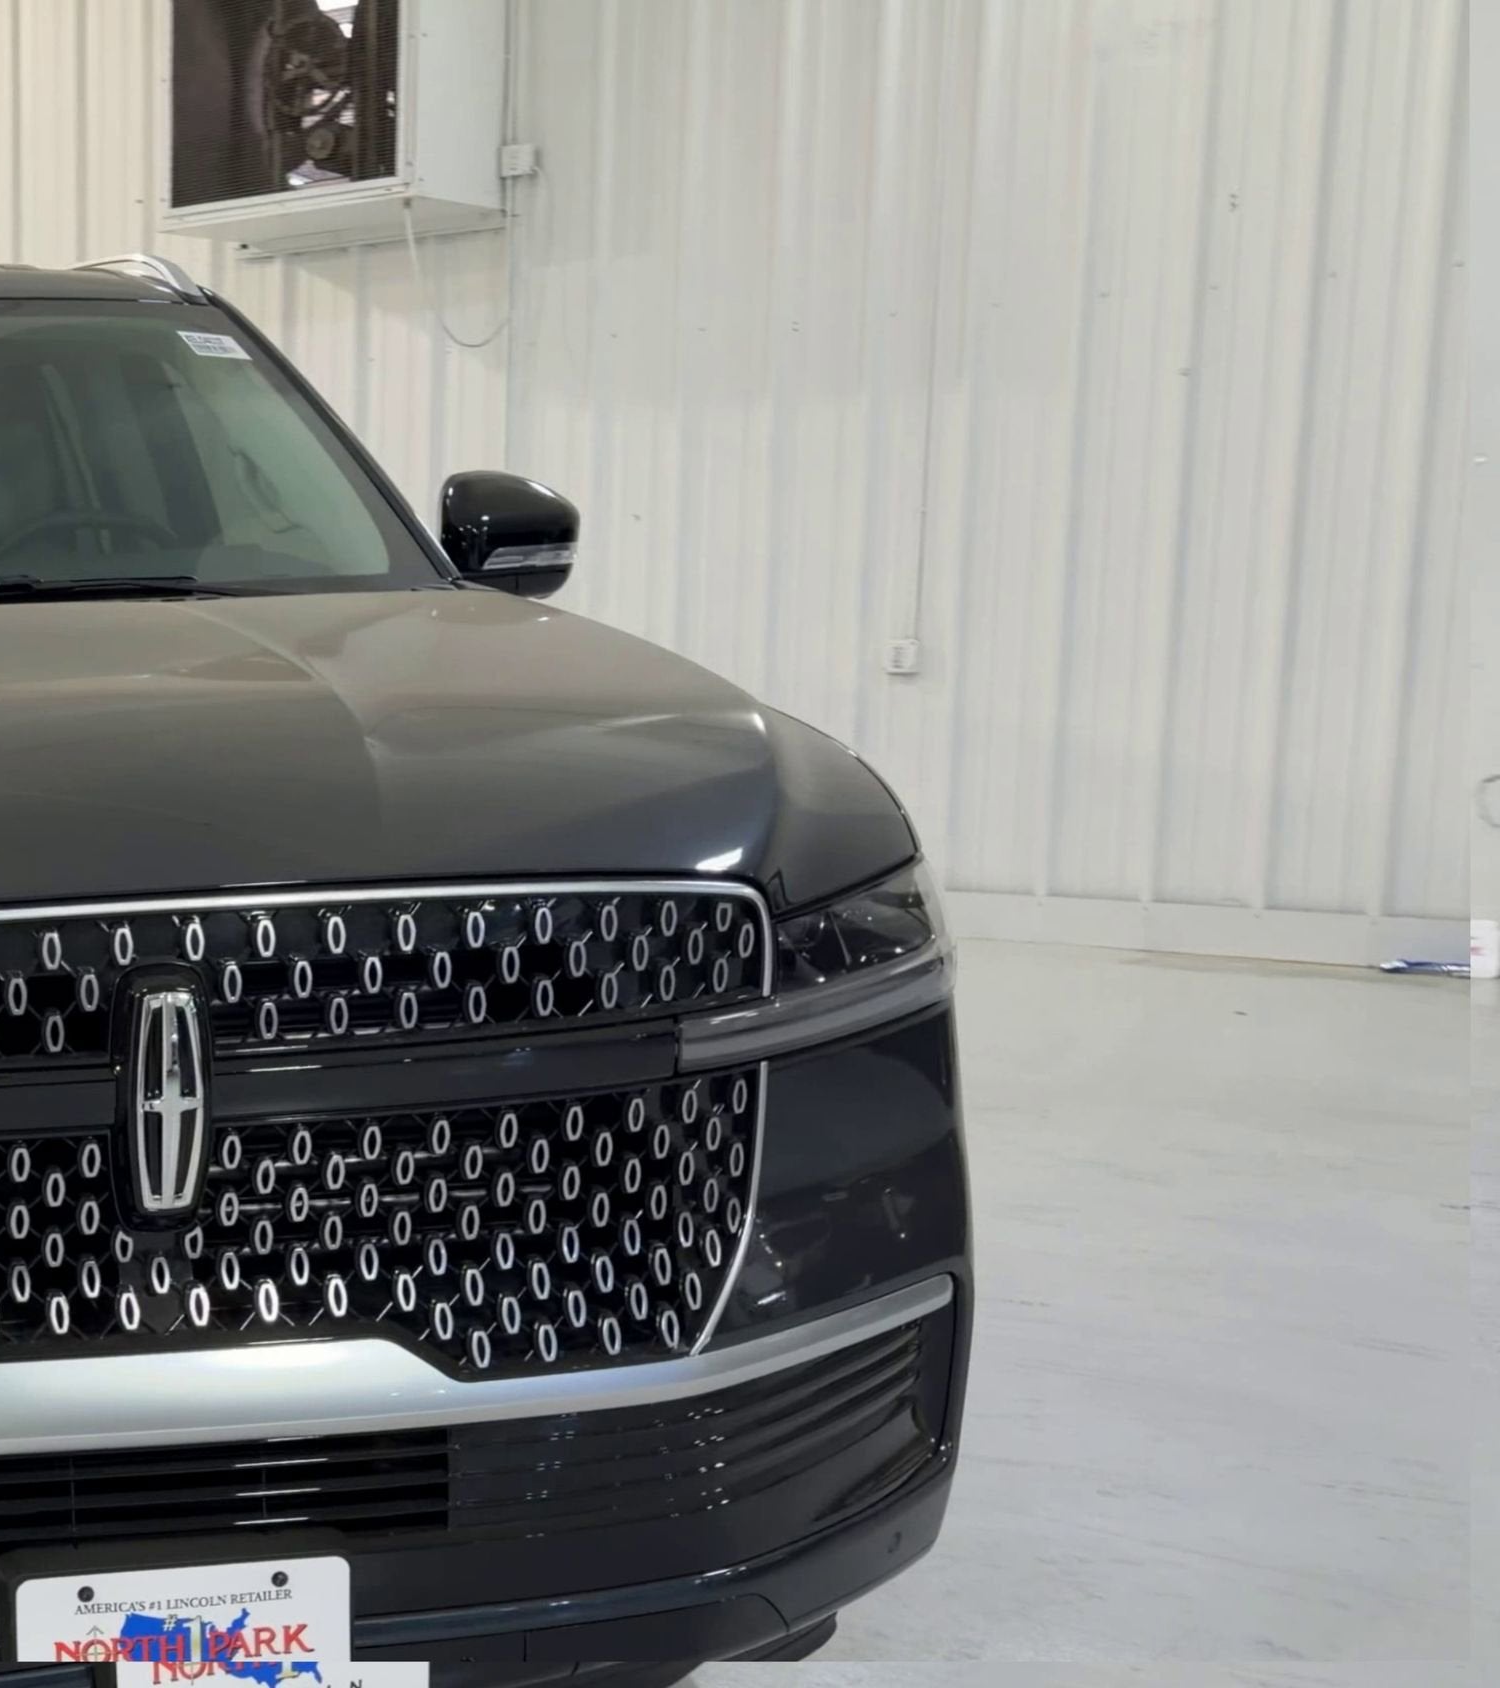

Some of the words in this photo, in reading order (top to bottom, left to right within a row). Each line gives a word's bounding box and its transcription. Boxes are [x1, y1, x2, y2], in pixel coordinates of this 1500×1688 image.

[74, 1600, 146, 1615] AMERICA'S
[148, 1600, 162, 1611] #1
[166, 1594, 227, 1610] LINCOLN
[230, 1588, 293, 1604] RETAILER
[54, 1633, 186, 1662] NORTH
[208, 1623, 315, 1660] PARK
